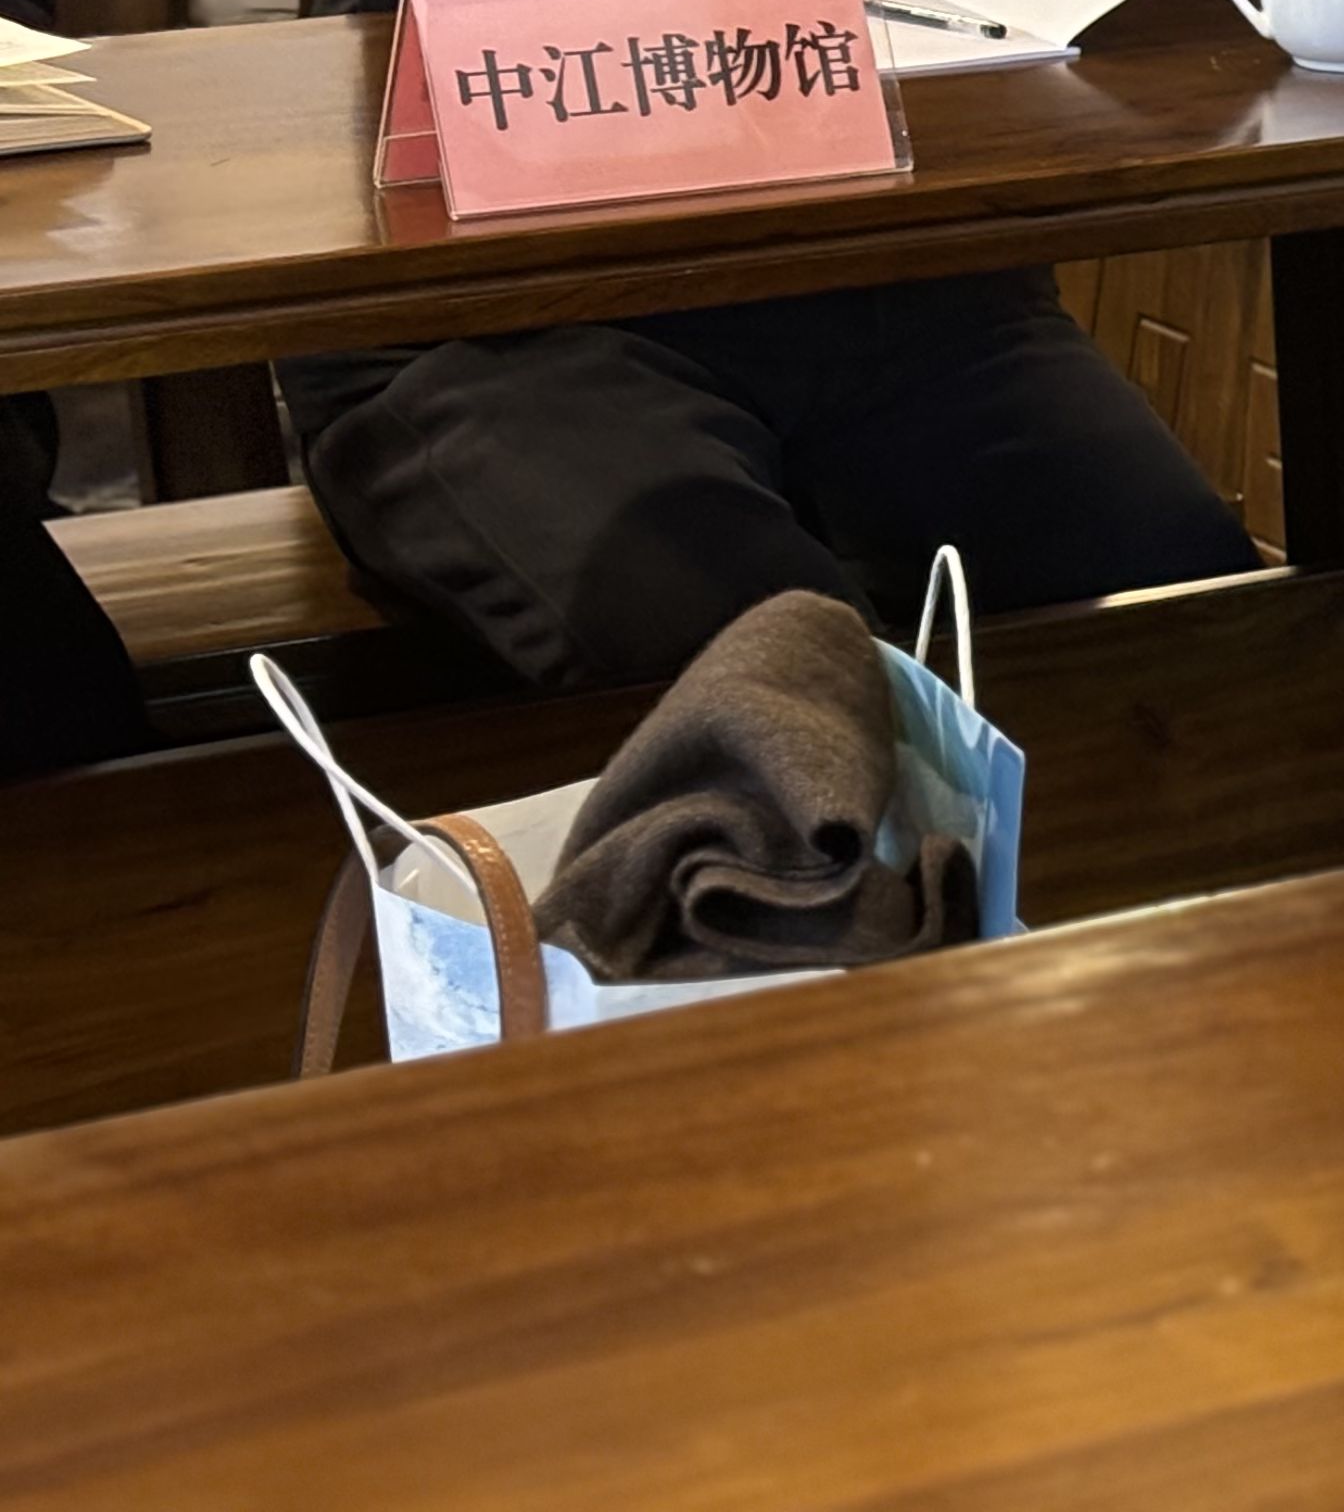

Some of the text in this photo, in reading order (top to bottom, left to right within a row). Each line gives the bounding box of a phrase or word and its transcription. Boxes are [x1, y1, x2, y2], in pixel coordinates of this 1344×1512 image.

[455, 21, 860, 131] 中江博物馆
